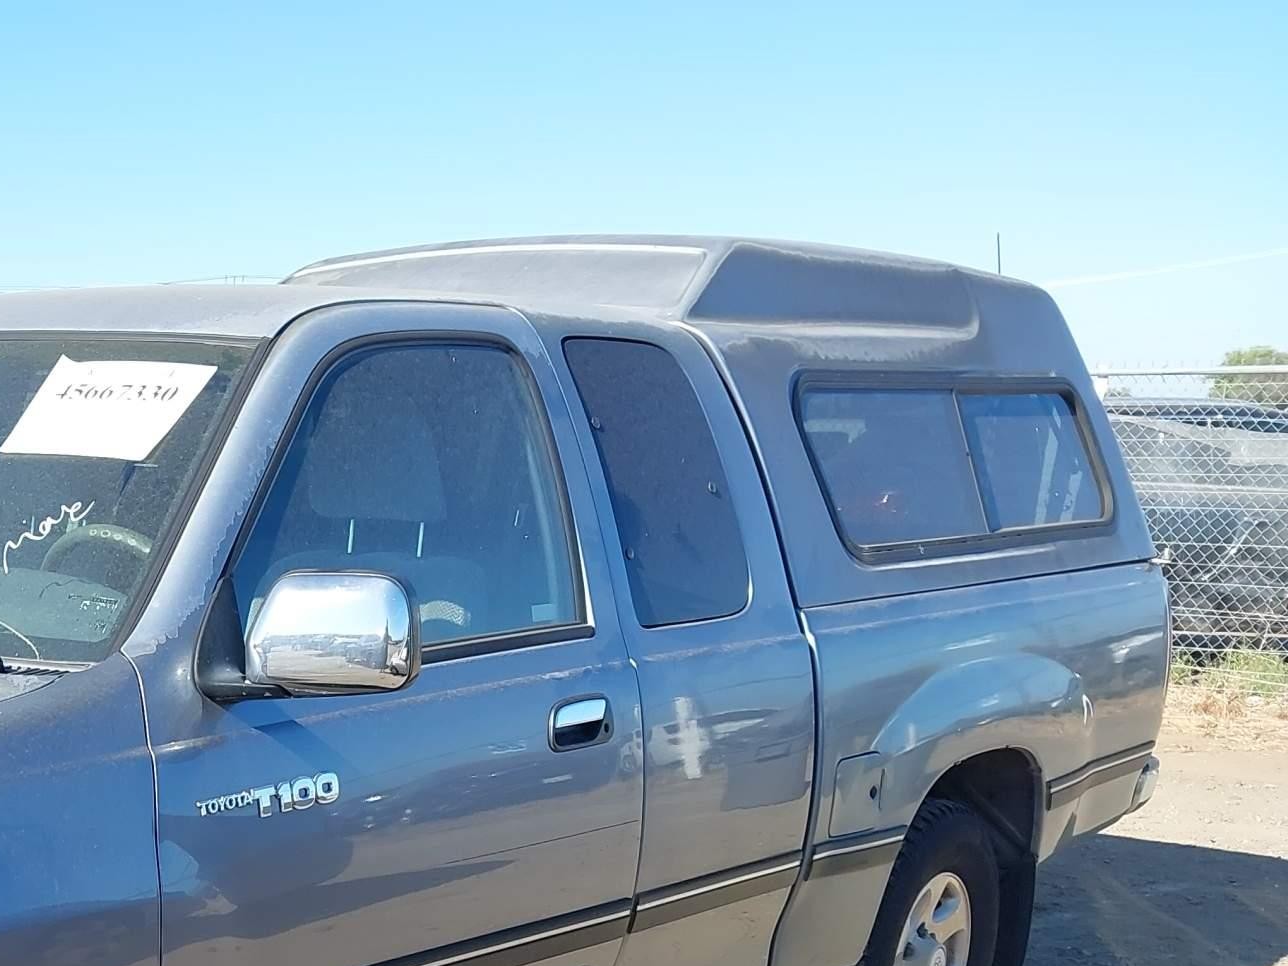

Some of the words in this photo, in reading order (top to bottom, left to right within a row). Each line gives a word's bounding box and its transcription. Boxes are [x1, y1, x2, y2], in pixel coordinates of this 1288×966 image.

[55, 383, 179, 401] 45667330
[197, 790, 253, 817] TOYOTA
[253, 771, 340, 818] T100
